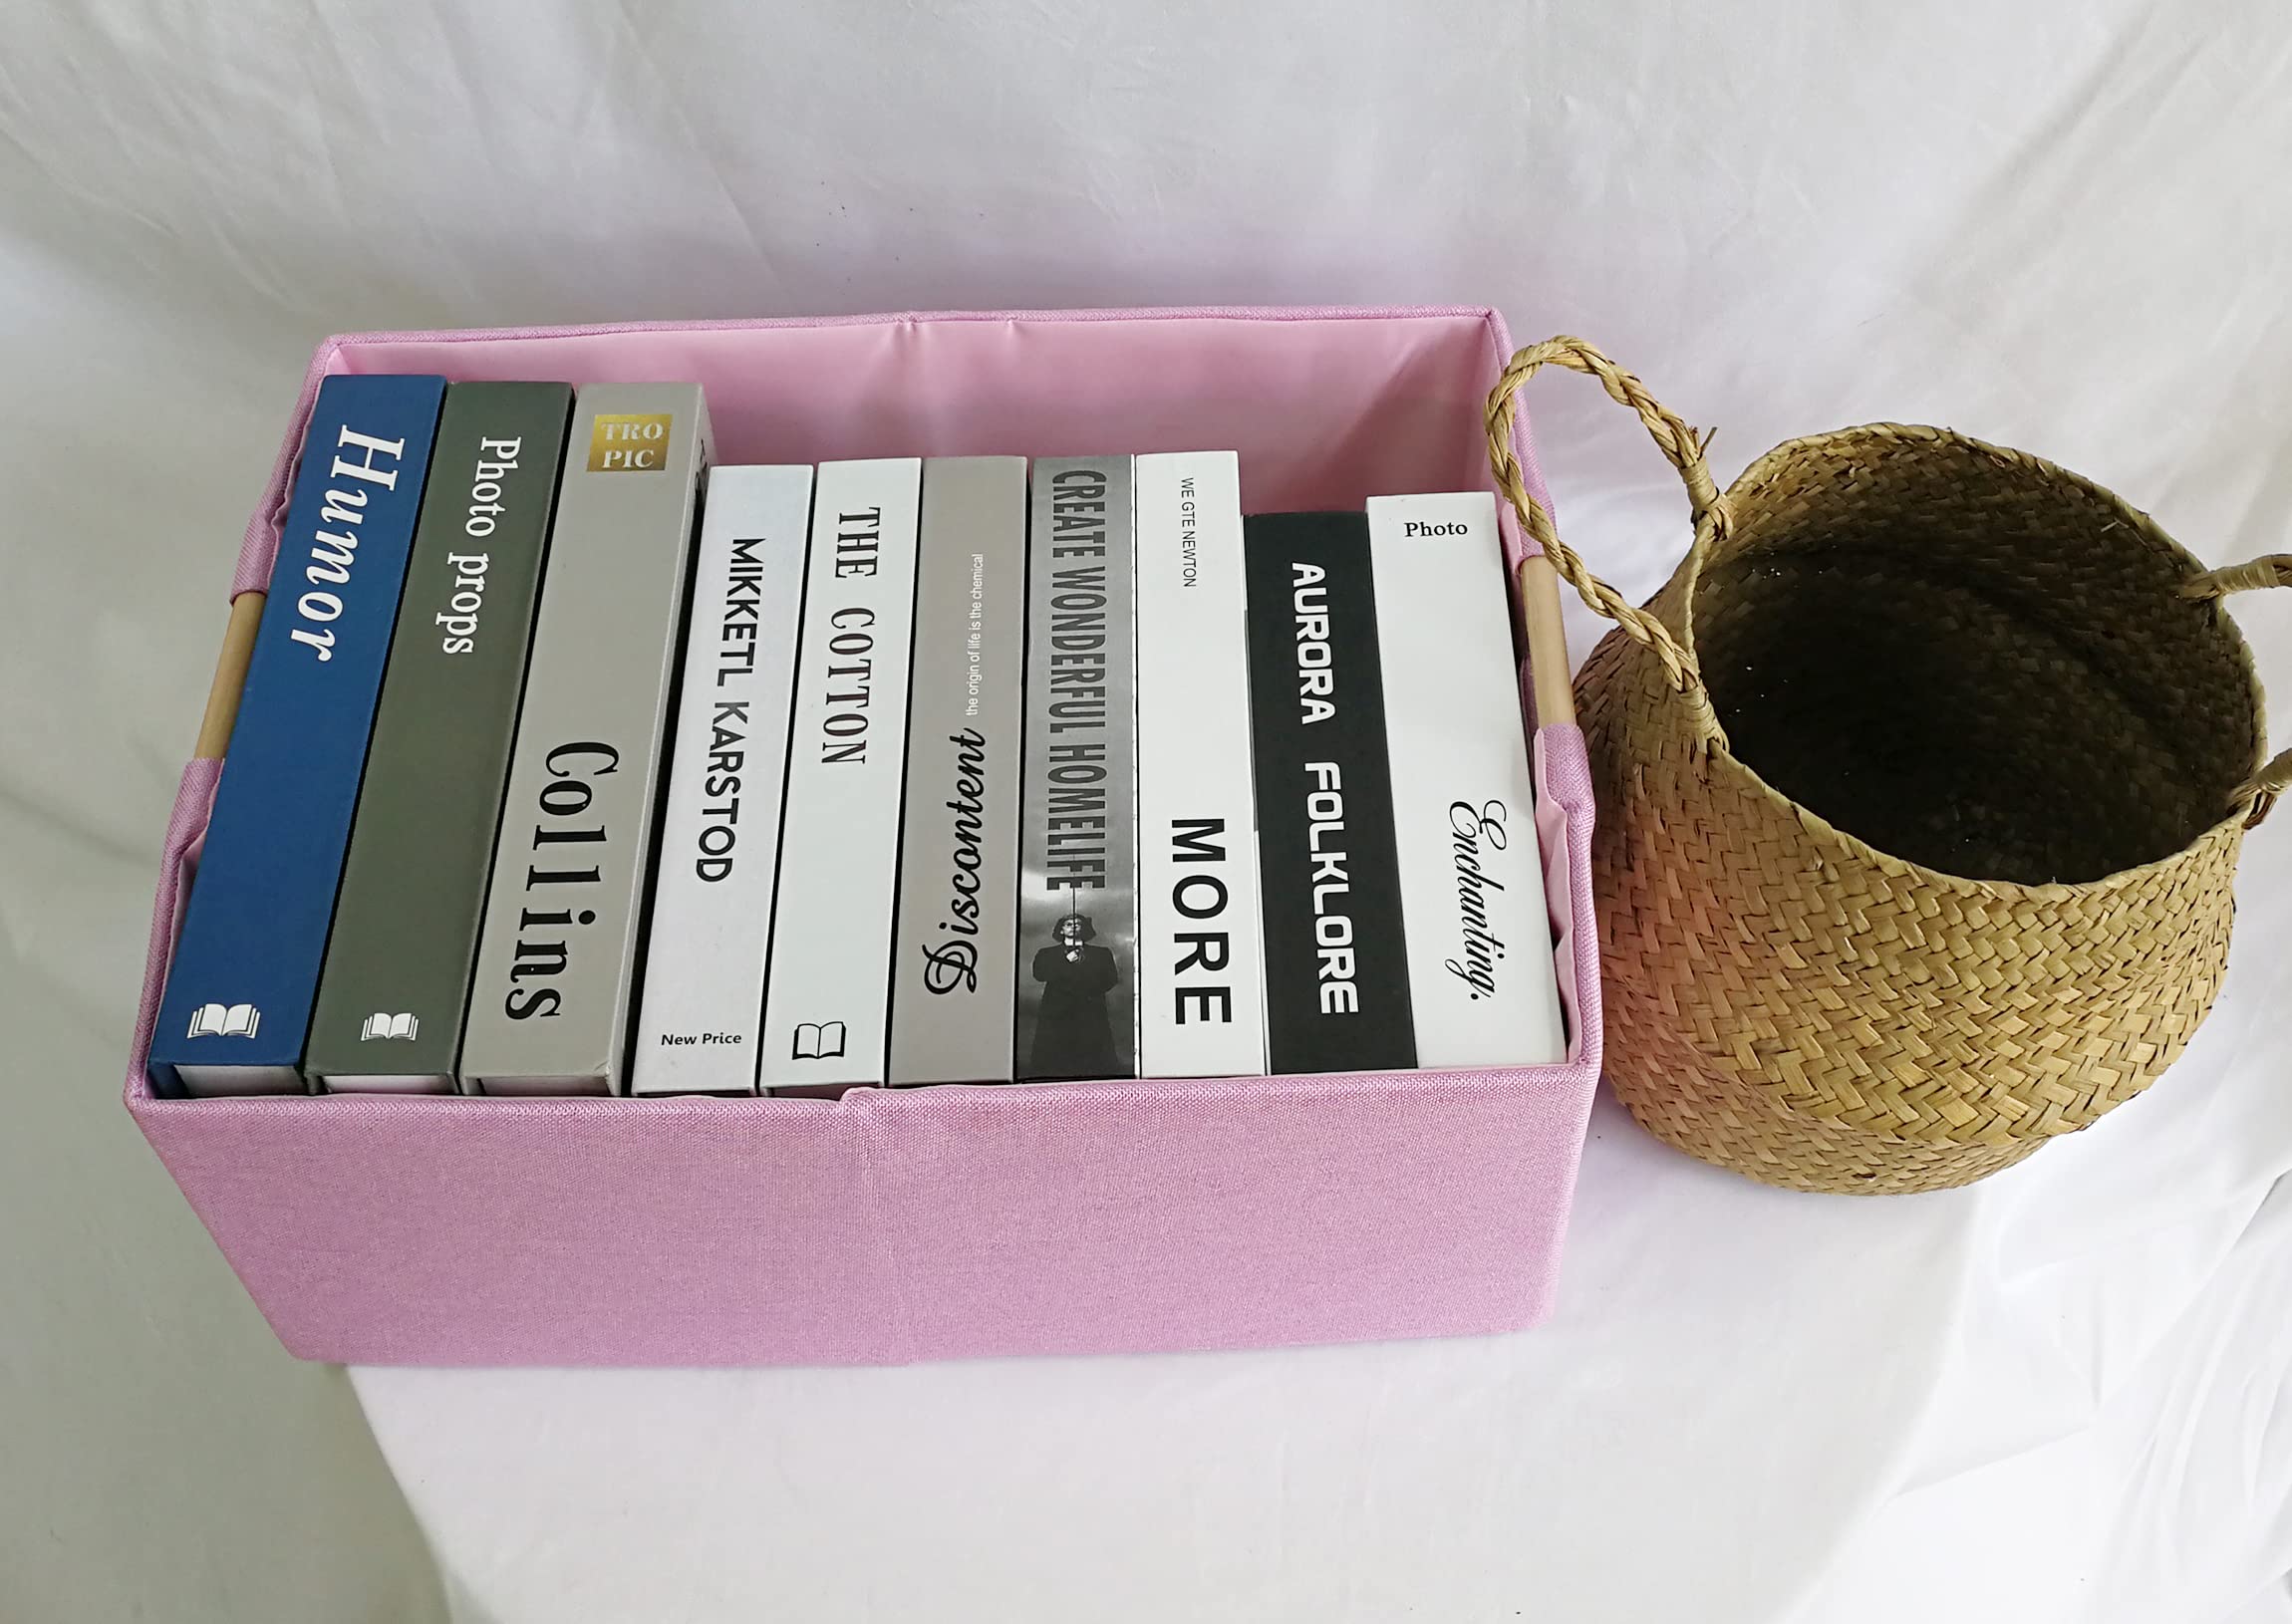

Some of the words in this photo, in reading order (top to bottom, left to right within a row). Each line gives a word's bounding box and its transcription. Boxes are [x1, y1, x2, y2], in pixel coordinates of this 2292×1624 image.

[601, 421, 664, 440] TRO
[602, 449, 655, 468] PIC
[464, 436, 522, 537] Photo
[1050, 469, 1108, 559] CREATE
[1181, 477, 1195, 498] WE
[1182, 501, 1196, 528] GTE
[291, 424, 405, 662] Humor
[834, 506, 881, 579] THE
[1182, 531, 1197, 588] NEWTON
[1404, 521, 1468, 537] Photo
[435, 551, 489, 655] props
[716, 538, 766, 686] MIKKETL
[969, 602, 982, 619] the
[971, 553, 984, 600] chemical
[967, 650, 981, 663] of
[968, 633, 981, 649] life
[969, 621, 982, 631] is
[1047, 565, 1108, 733] WONDERFUL
[1292, 563, 1336, 725] AURORA
[821, 607, 876, 764] COTTON
[966, 697, 979, 716] the
[967, 665, 982, 695] origin
[696, 700, 750, 883] KARSTOD
[1046, 743, 1108, 891] HOMELIFE
[504, 740, 620, 1020] Collins
[922, 727, 987, 994] Discontent
[1304, 761, 1359, 1014] FOLKLORE
[1171, 818, 1232, 1025] MORE
[661, 1033, 698, 1046] New
[702, 1032, 742, 1045] Price
